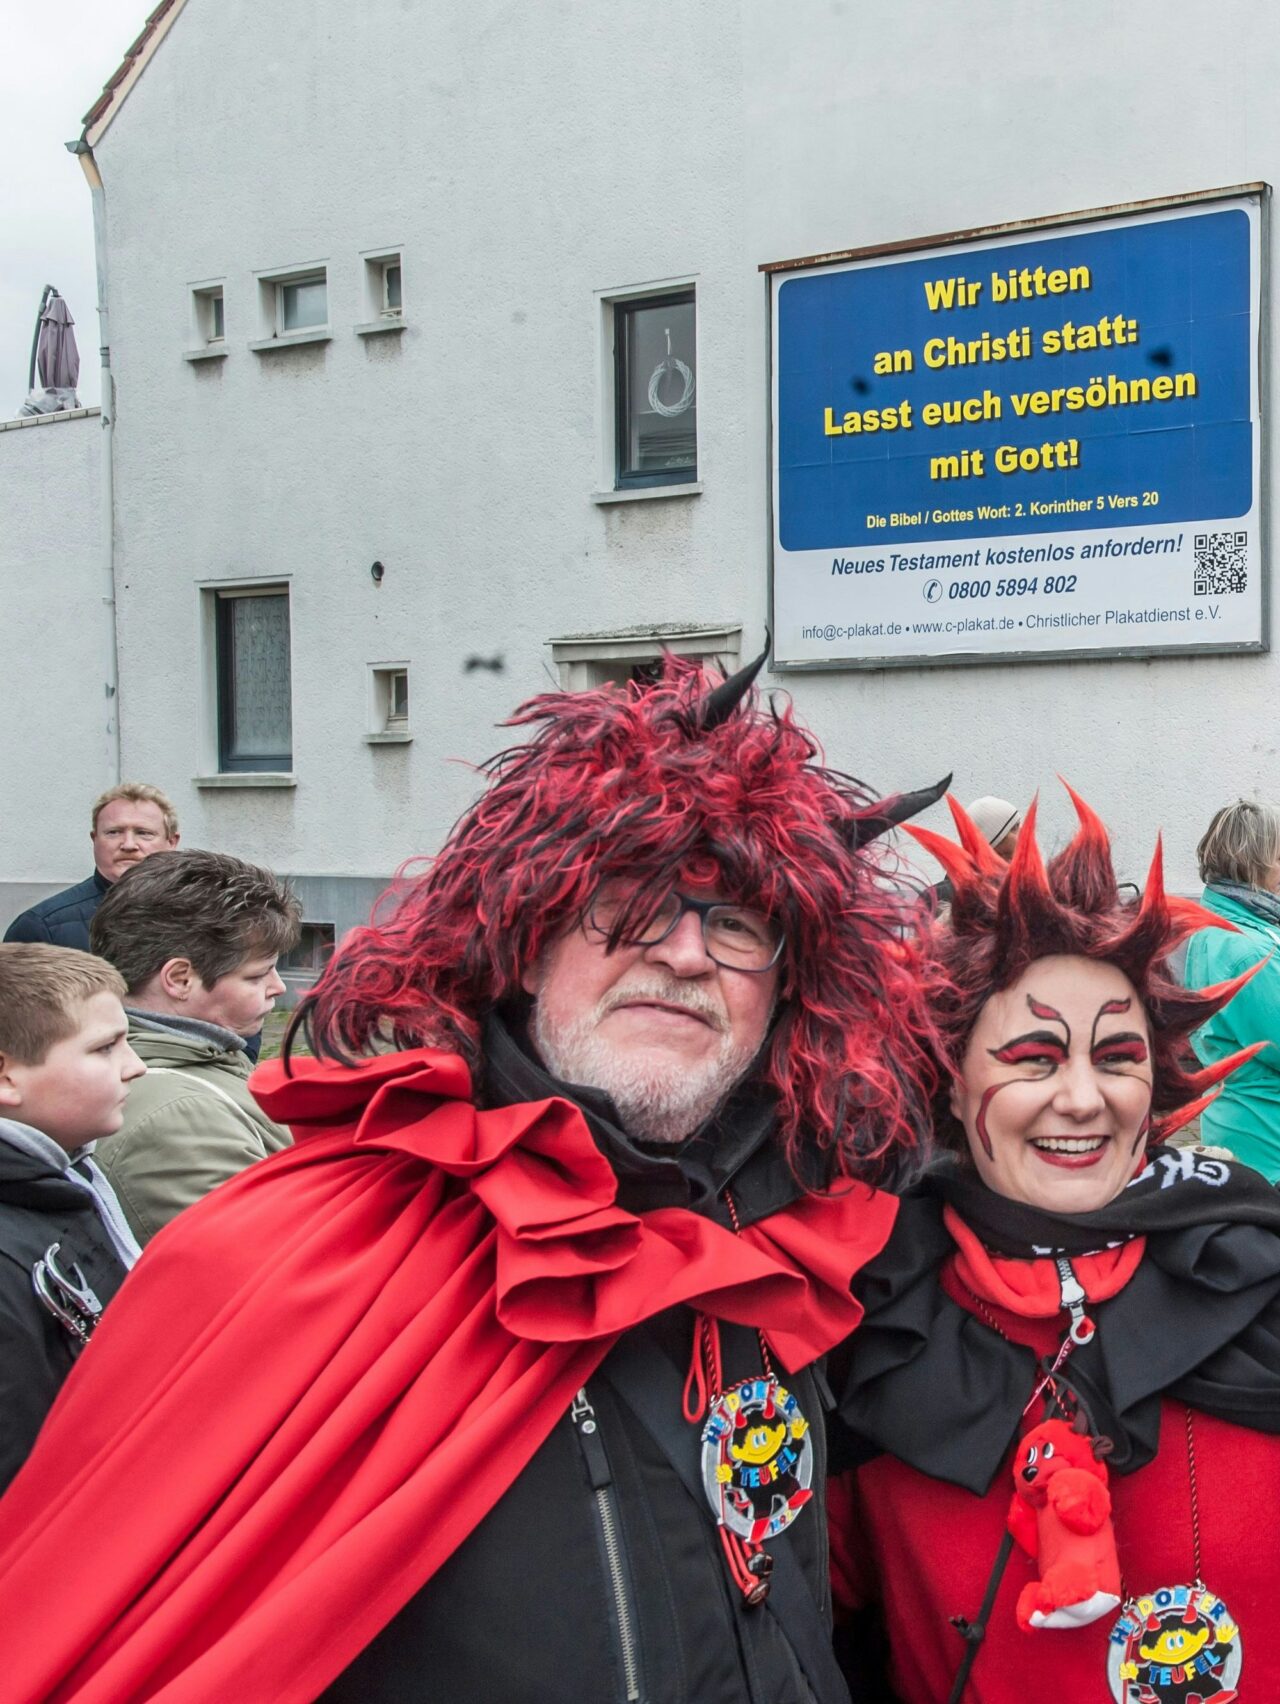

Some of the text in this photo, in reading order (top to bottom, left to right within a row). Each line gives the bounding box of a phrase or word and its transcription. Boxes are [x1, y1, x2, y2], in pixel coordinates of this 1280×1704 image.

[925, 266, 1090, 310] Wir bitten
[873, 315, 1137, 374] an Christi statt:
[824, 372, 1196, 435] Lasst euch versöhnen
[931, 439, 1078, 479] mit Gott!
[866, 515, 887, 528] Die
[890, 512, 921, 527] Bibel
[932, 508, 974, 523] Gottes
[977, 505, 1011, 520] Wort:
[1015, 503, 1026, 517] 2.
[1030, 497, 1092, 515] Korinther
[1096, 496, 1104, 510] 5
[1108, 494, 1138, 508] Vers
[1142, 491, 1159, 506] 20
[831, 534, 1183, 575] Neues Testament kostenlos anfordern!
[948, 574, 1078, 599] 0800 5894 802
[802, 604, 1222, 641] info@c-plakat.de www.c-plakat.de Christlicher Plakatdienst e.V.
[741, 1446, 798, 1489] TEUFEL
[1149, 1650, 1221, 1686] TEUFEL
